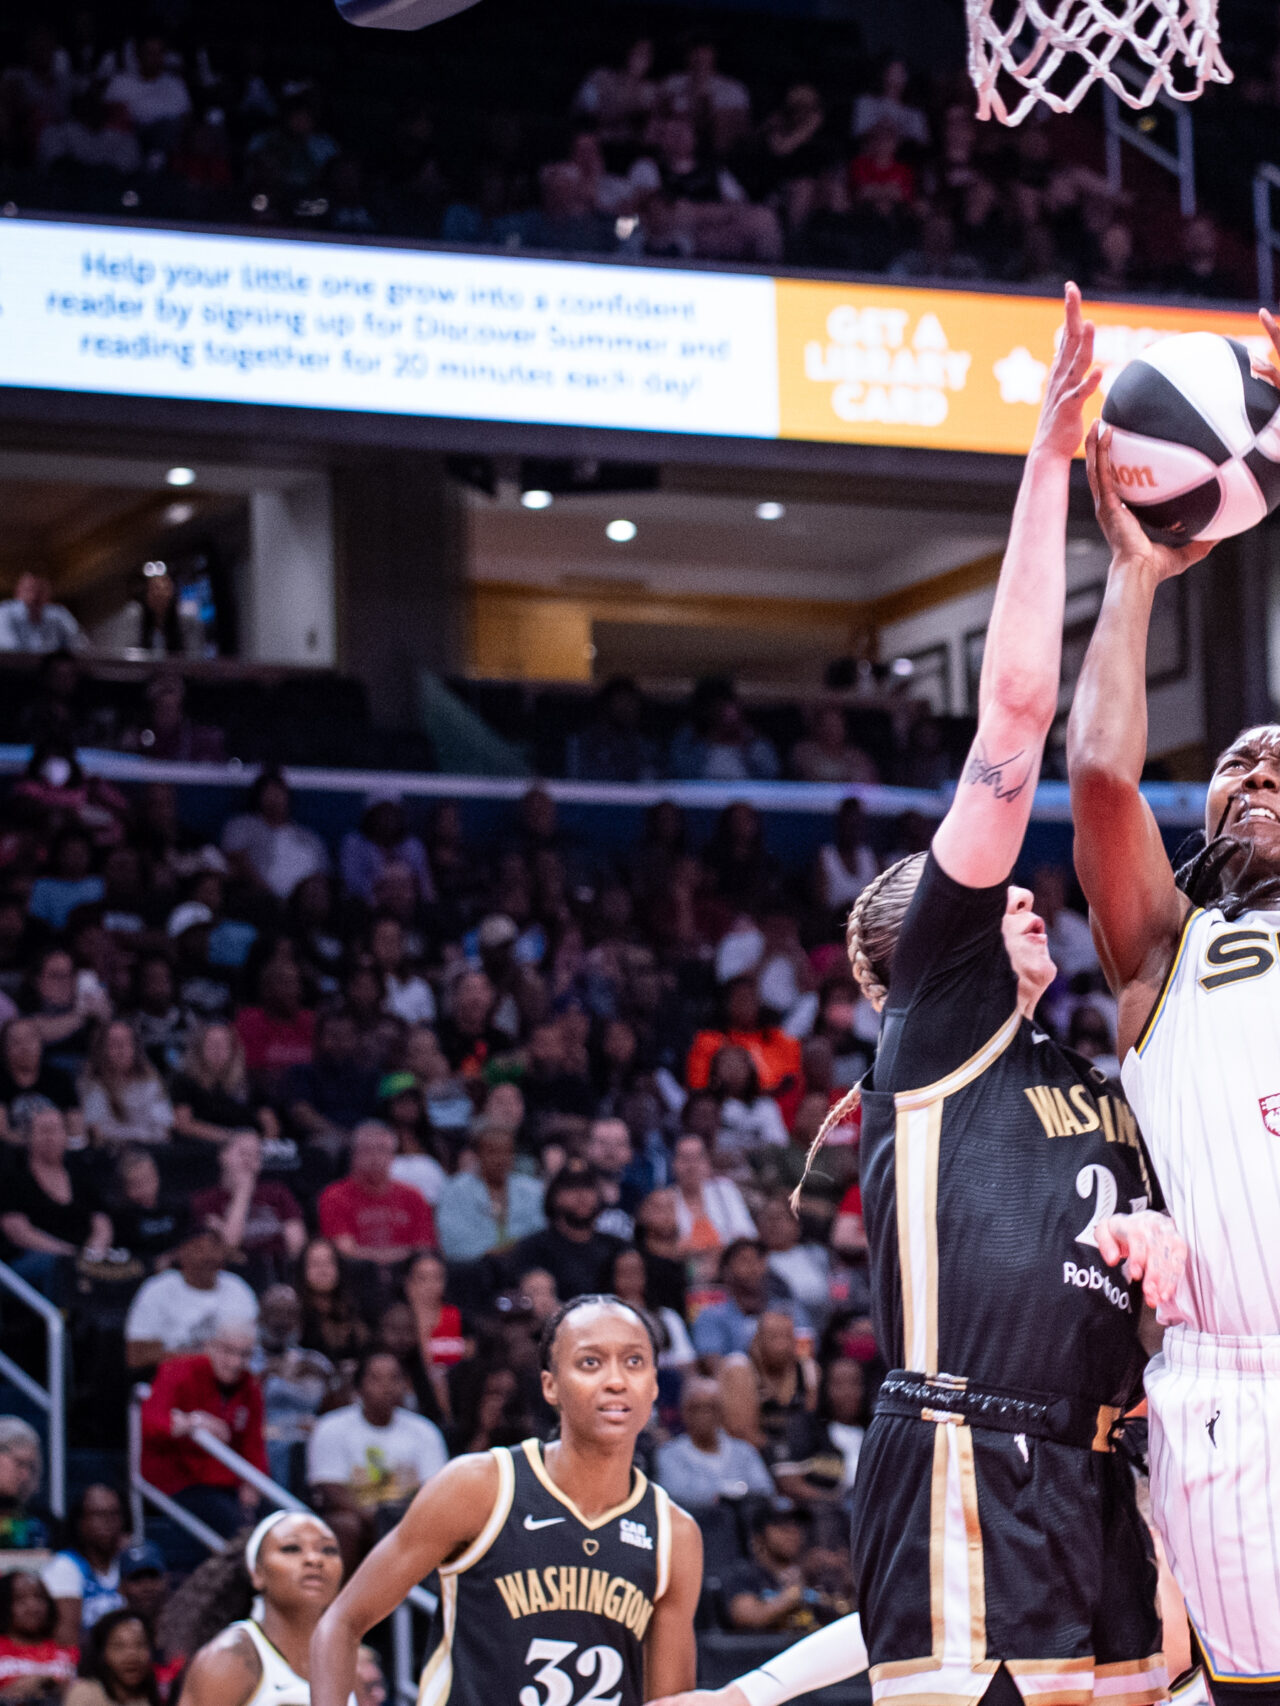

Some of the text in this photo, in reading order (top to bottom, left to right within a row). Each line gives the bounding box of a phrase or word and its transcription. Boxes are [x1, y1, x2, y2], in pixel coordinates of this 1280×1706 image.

[82, 251, 696, 320] Help your little one grow into a confident
[46, 291, 731, 361] reader by signing up for Discover Summer and
[826, 304, 949, 350] GET A
[79, 333, 196, 369] reading
[204, 338, 330, 375] together
[341, 345, 381, 375] for
[393, 351, 429, 379] 20
[437, 361, 554, 387] minutes
[565, 368, 632, 389] each
[804, 340, 972, 390] LIBRARY
[831, 381, 949, 426] CARD
[619, 1518, 647, 1537] CAR
[494, 1566, 654, 1641] WASHINGTON
[519, 1638, 624, 1706] 32
